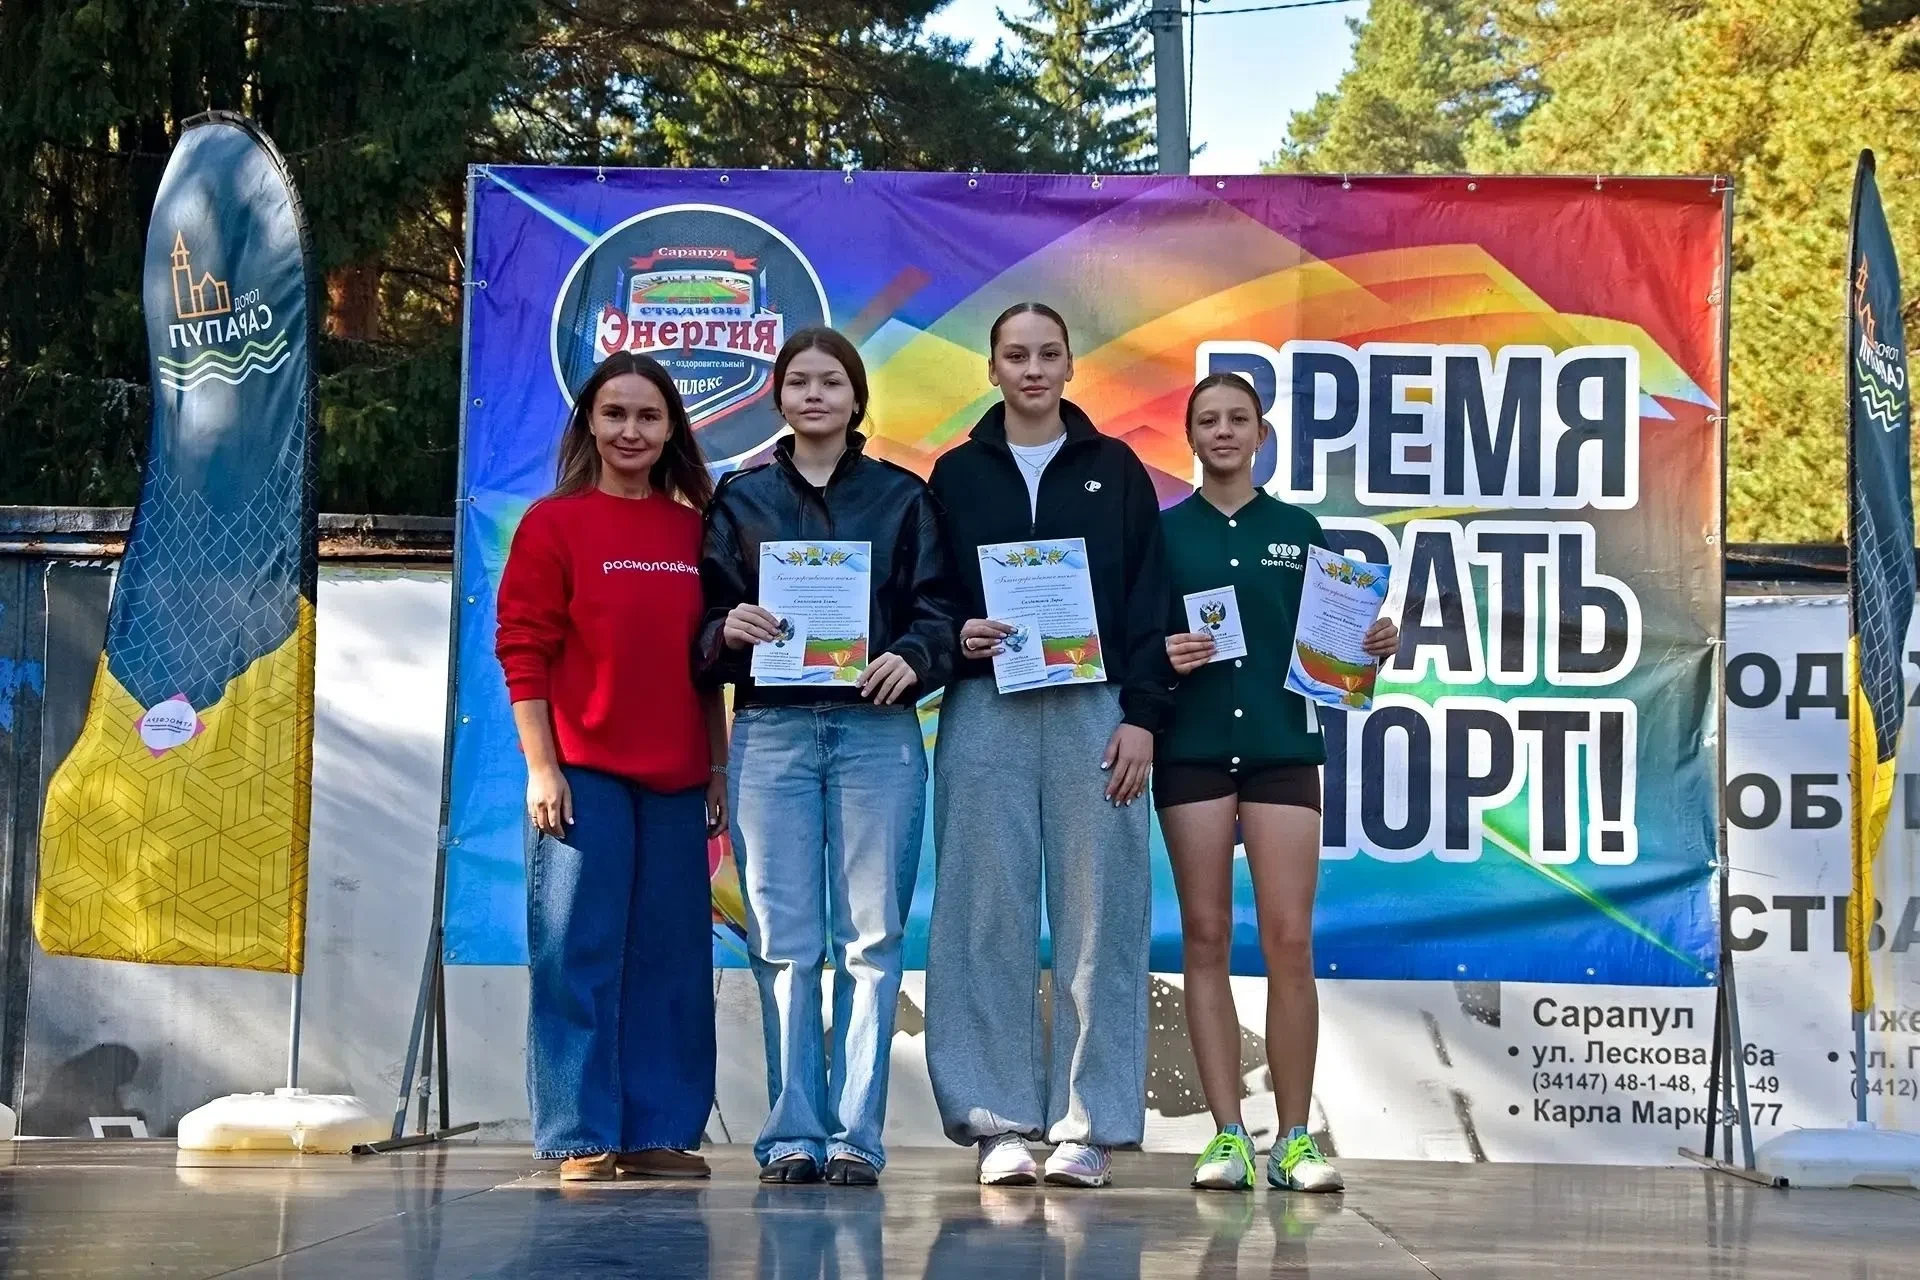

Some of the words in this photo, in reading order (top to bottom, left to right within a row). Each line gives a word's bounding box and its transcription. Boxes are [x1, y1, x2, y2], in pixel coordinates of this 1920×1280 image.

[658, 247, 729, 259] Сарапул
[601, 303, 778, 357] Энергия
[674, 376, 723, 396] плекс
[1261, 558, 1284, 567] Open
[1324, 528, 1629, 673] АТЬ
[1725, 652, 1920, 720] ОД
[1318, 704, 1626, 853] ОРТ!
[1533, 997, 1694, 1036] Сарапул
[1532, 1045, 1575, 1068] ул.
[1532, 1072, 1607, 1094] (34147)
[1614, 1073, 1696, 1094] 48-1-48,
[1534, 1098, 1621, 1128] Карла
[1750, 1103, 1783, 1126] 77
